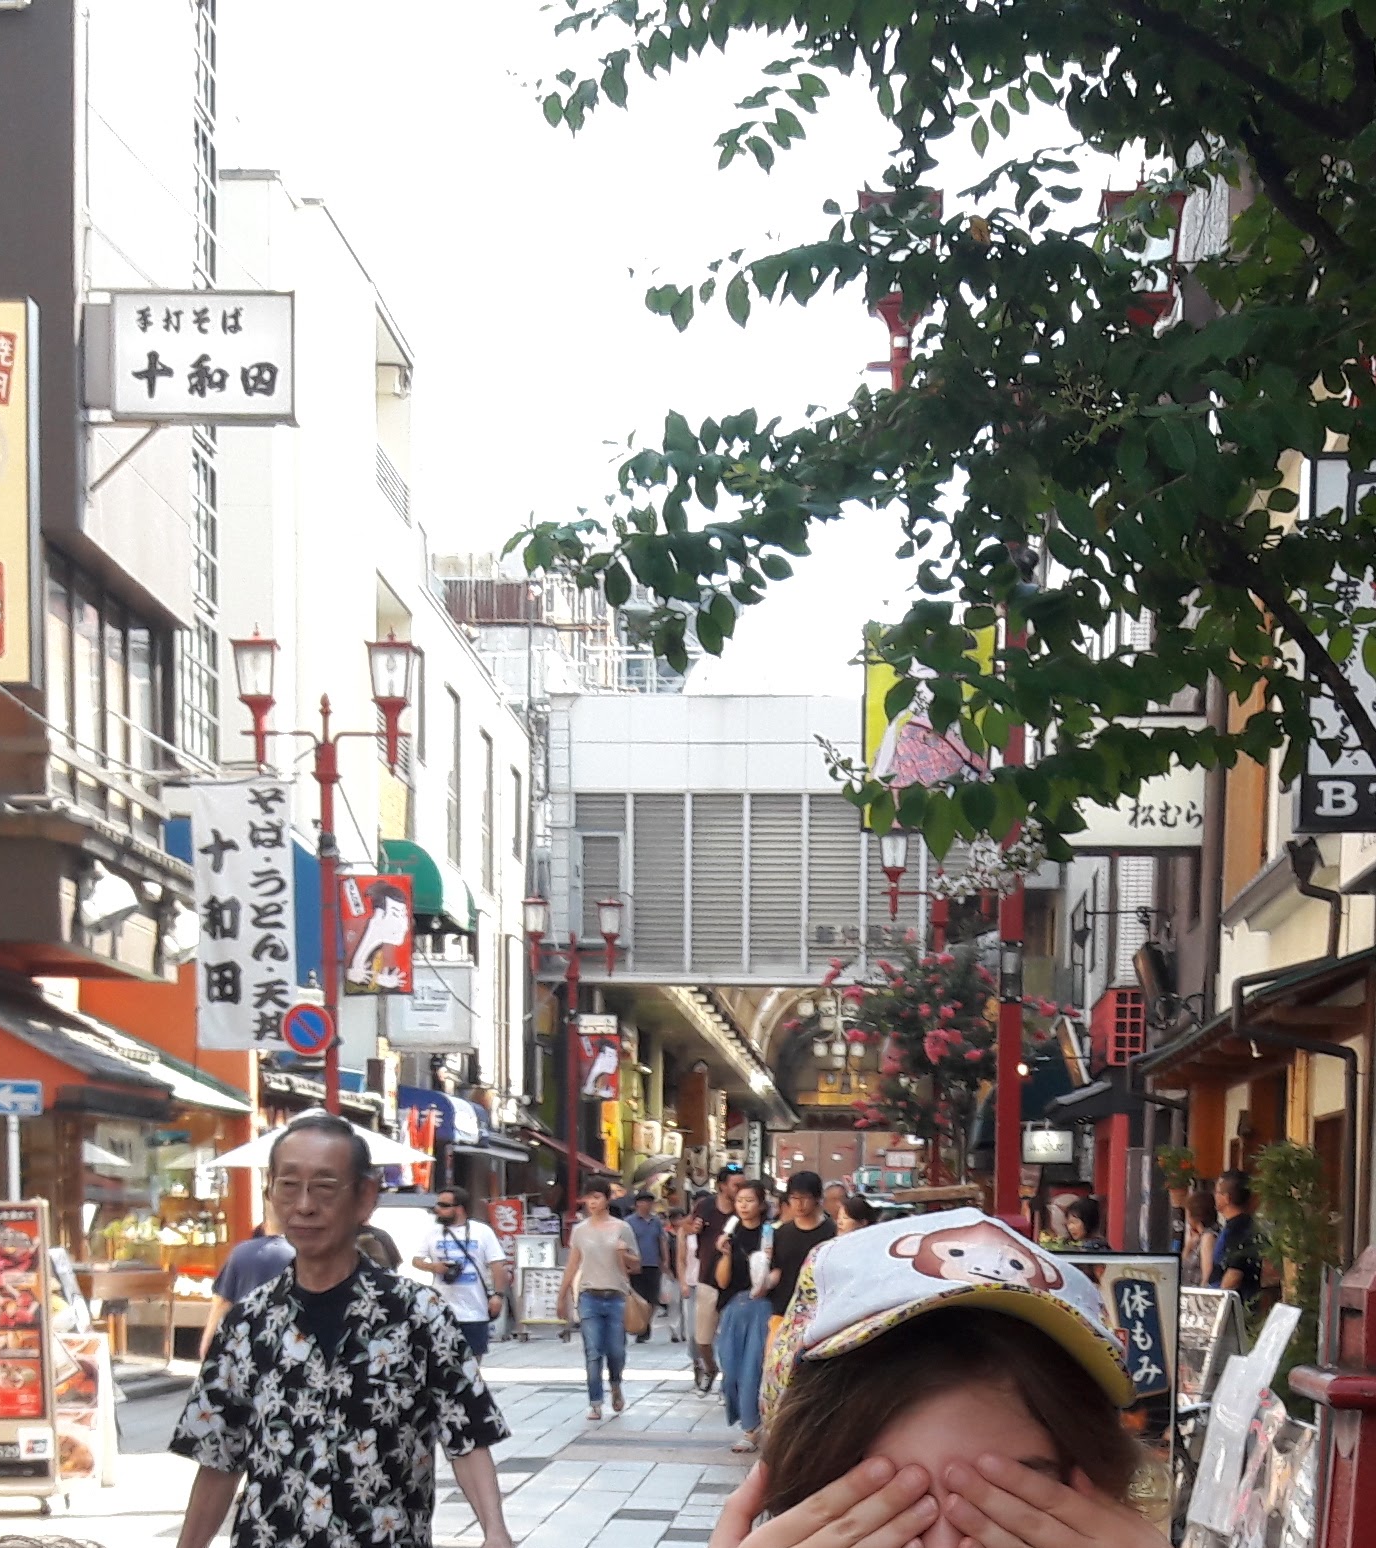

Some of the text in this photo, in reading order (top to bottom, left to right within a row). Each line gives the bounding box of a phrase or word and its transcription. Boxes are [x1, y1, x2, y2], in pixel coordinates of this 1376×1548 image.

[135, 306, 244, 335] 手打そば
[131, 350, 279, 399] 十和田
[1128, 802, 1204, 828] 松むら
[198, 829, 242, 1005] 十和田
[1120, 1286, 1164, 1386] 体もみ
